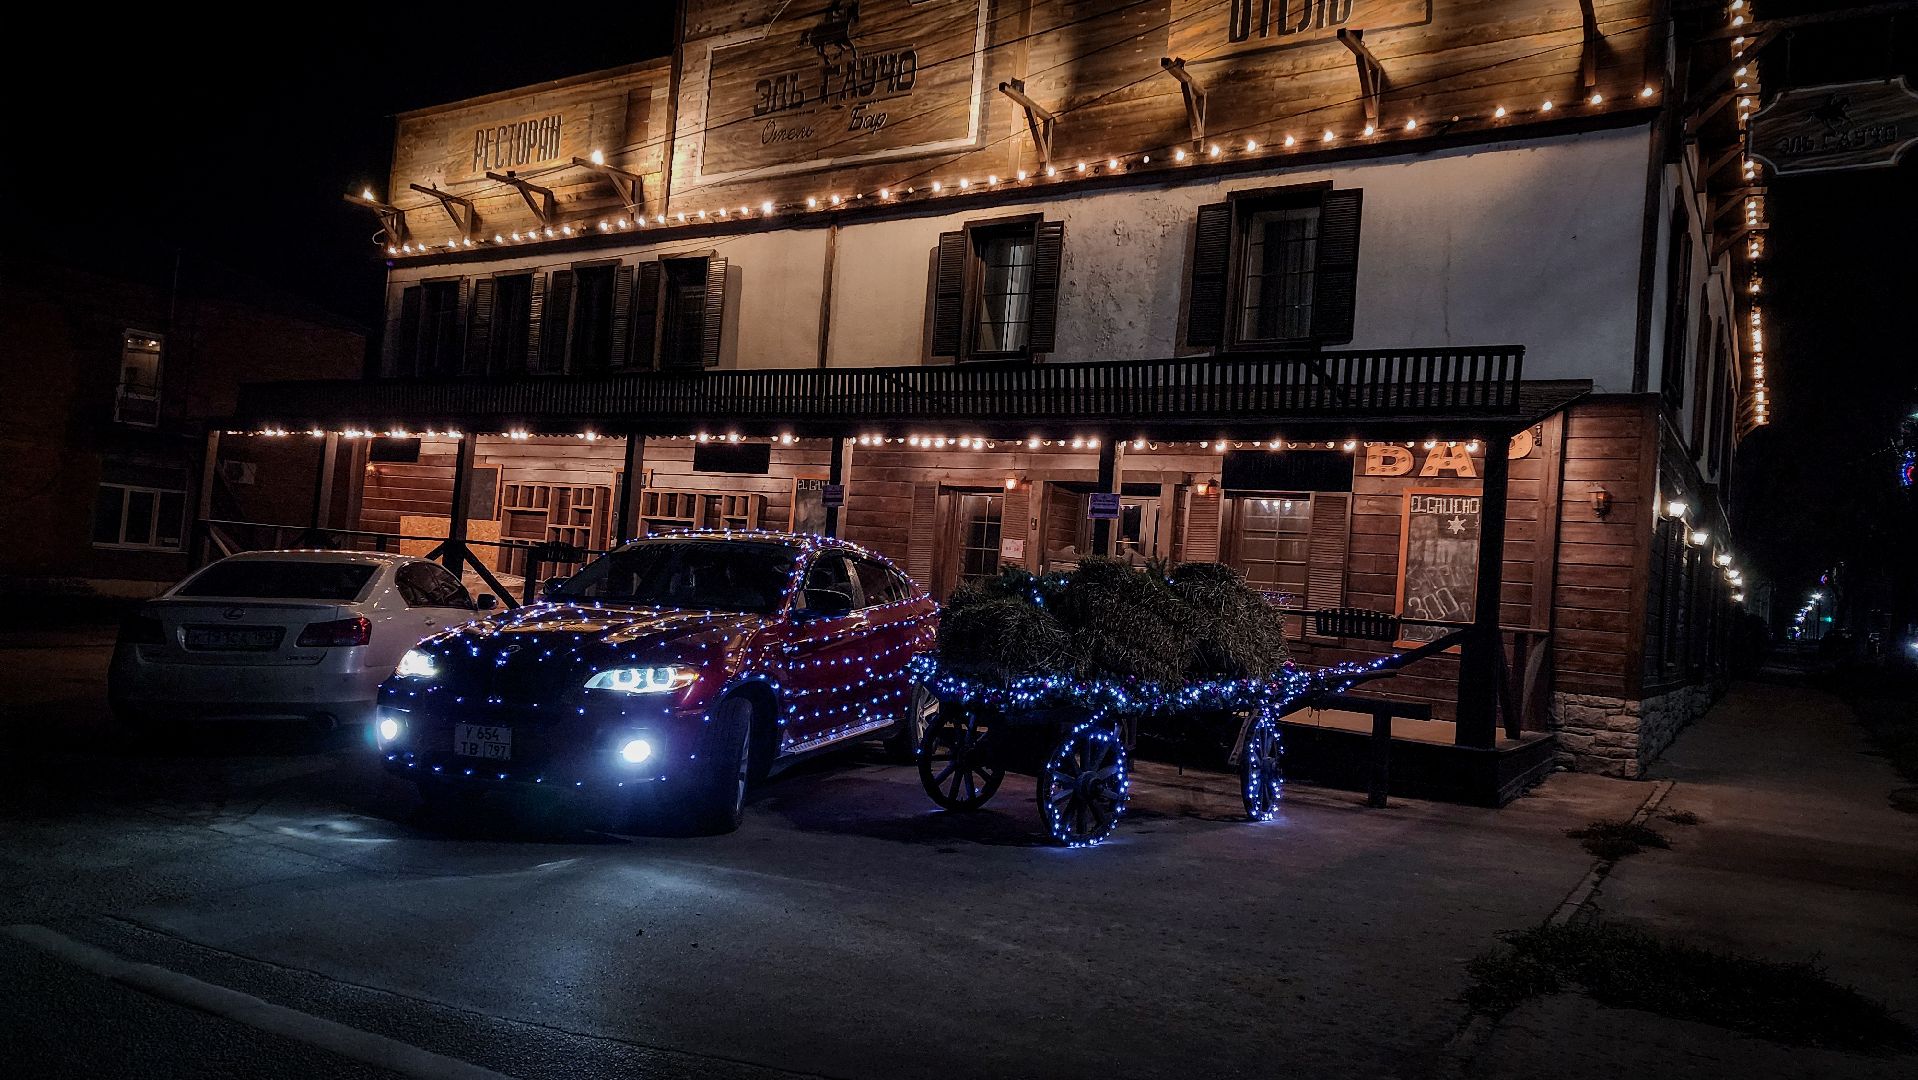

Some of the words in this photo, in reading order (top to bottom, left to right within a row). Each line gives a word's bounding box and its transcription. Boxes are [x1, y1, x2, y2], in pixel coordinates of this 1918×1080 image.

[753, 72, 806, 116] ЭЛЬ
[820, 50, 918, 104] ГАУЧО
[472, 114, 562, 173] РЕСТОРАН
[761, 119, 816, 145] Отель
[848, 104, 888, 135] Бар
[477, 726, 500, 741] 654
